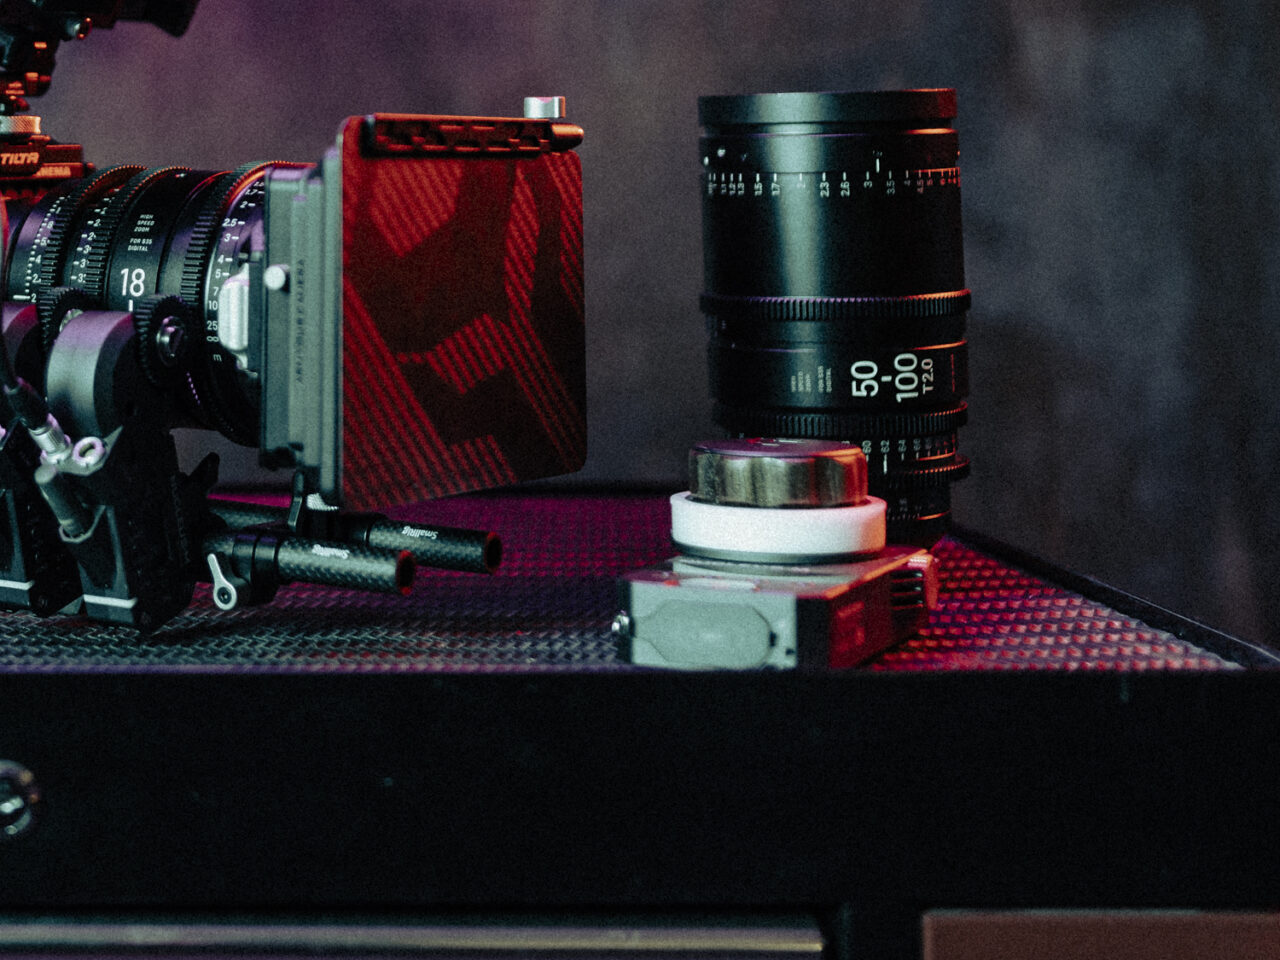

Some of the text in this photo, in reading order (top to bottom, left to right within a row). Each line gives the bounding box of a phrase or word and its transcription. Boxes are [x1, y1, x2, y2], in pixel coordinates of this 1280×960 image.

[0, 152, 39, 165] TILTA
[820, 182, 829, 197] 2.3
[841, 181, 850, 197] 2.6
[222, 218, 238, 227] 2.5
[224, 233, 231, 242] 3
[218, 254, 224, 264] 4
[215, 268, 221, 278] 5
[121, 268, 146, 297] 18
[213, 287, 219, 296] 7
[208, 301, 218, 310] 10
[207, 320, 218, 331] 25
[851, 361, 878, 397] 50
[894, 353, 919, 402] 100
[922, 358, 933, 394] T2.0
[402, 525, 438, 540] SmallRig
